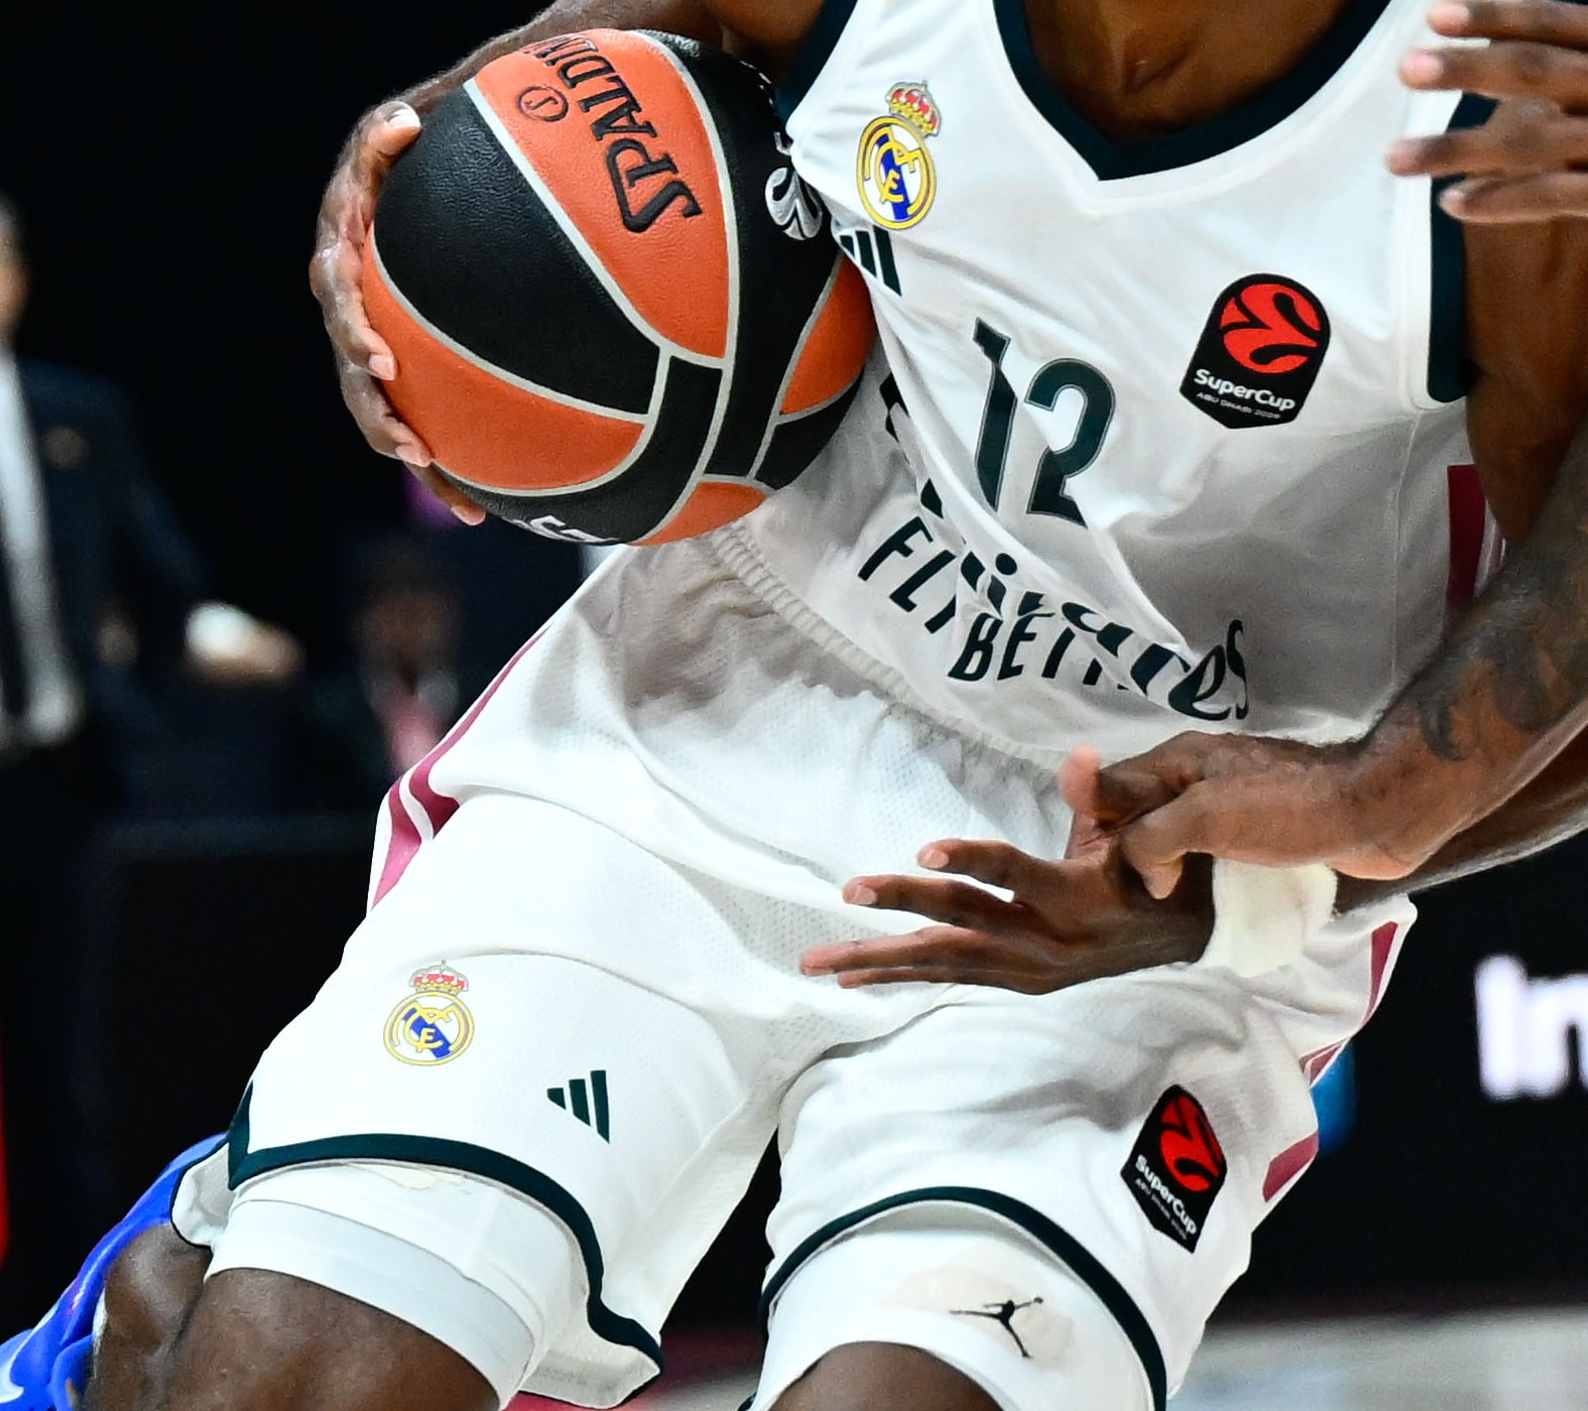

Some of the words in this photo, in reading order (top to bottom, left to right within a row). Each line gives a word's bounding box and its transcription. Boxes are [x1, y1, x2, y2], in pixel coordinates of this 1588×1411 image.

[524, 34, 703, 234] SPALDI
[974, 317, 1116, 529] 12
[1193, 368, 1296, 412] SuperCup
[1134, 1153, 1197, 1235] SuperCup
